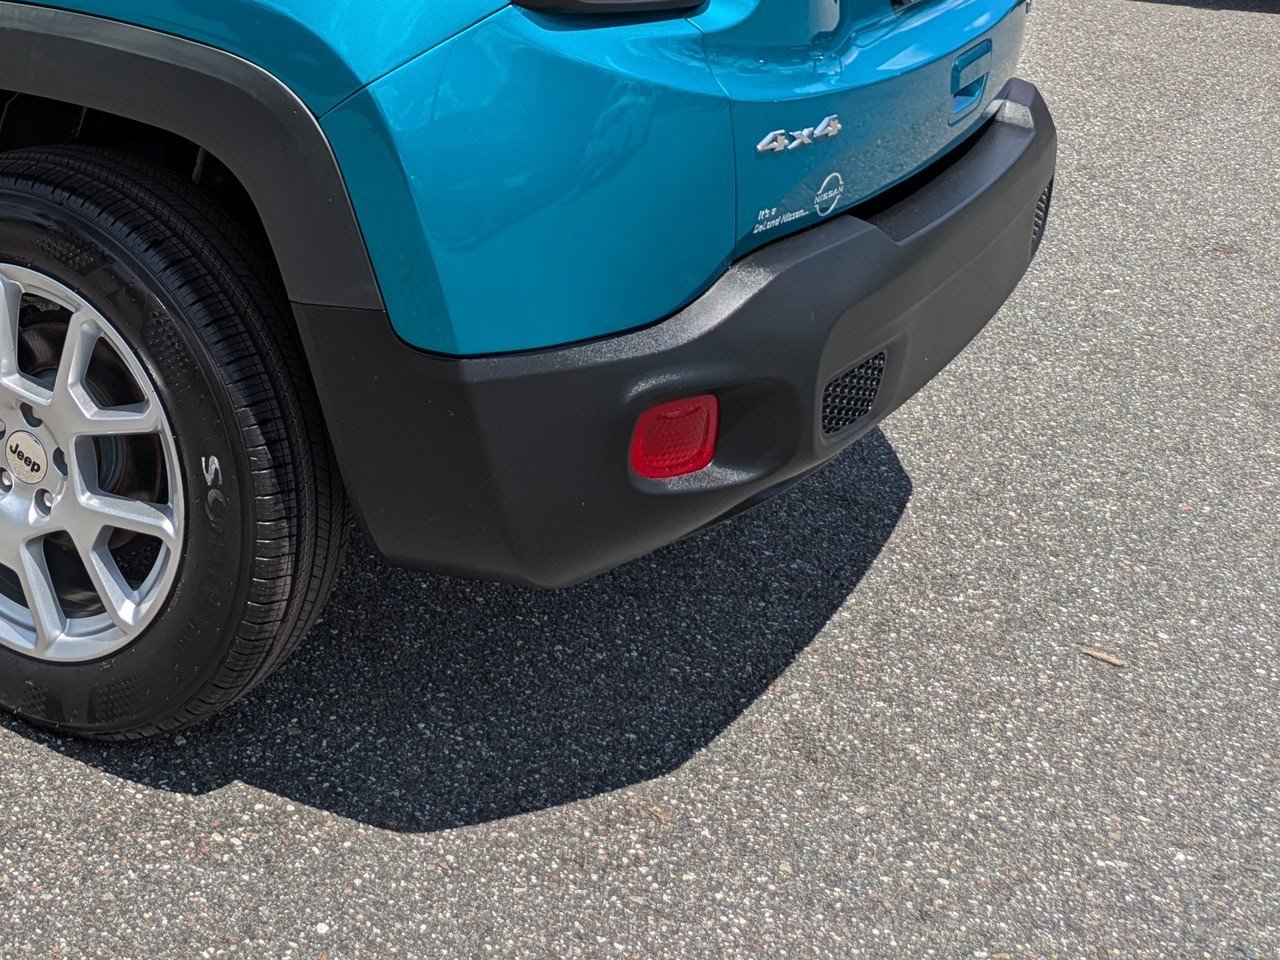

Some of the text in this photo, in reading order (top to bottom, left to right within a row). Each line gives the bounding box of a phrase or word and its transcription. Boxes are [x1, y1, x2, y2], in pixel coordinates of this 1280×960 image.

[756, 113, 842, 152] 4x4
[814, 185, 844, 204] NISSAN
[9, 443, 41, 473] Jeep
